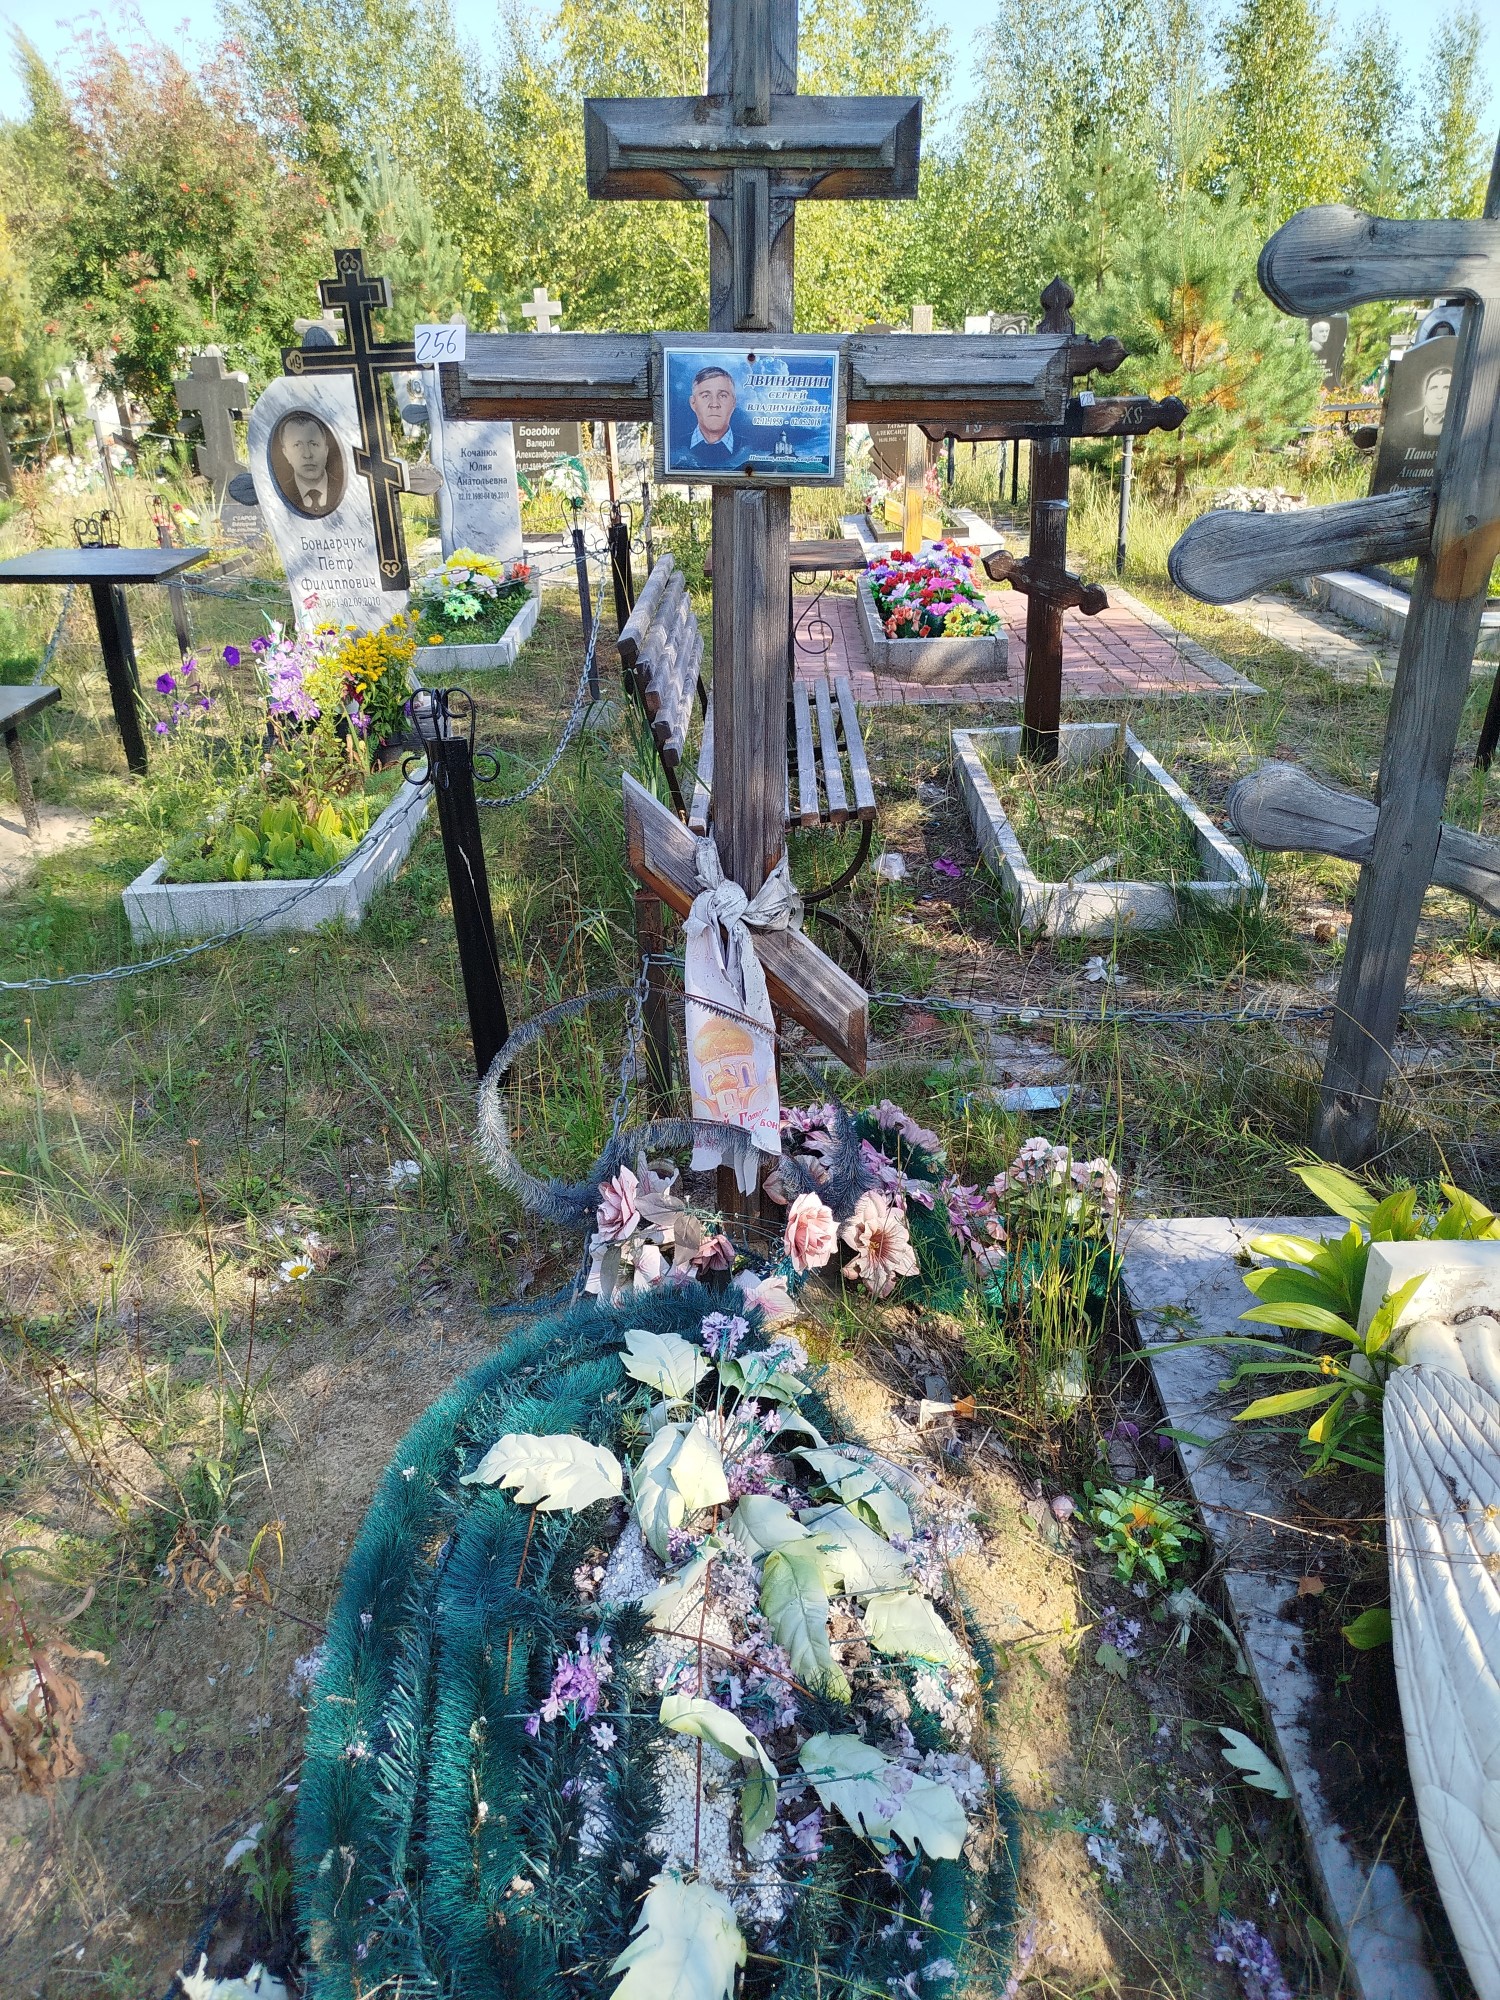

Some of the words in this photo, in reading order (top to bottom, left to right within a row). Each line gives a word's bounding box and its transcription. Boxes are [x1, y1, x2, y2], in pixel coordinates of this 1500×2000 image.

[416, 329, 457, 361] 256
[744, 375, 831, 388] ДВИНЯНИН
[768, 390, 808, 400] СЕРГЕЙ
[746, 404, 830, 413] ВЛАДИМИРОВИЧ
[519, 425, 561, 436] Богодюк
[526, 438, 555, 448] Валерий
[460, 448, 498, 458] Кочанюк
[469, 462, 492, 471] Юлия
[1397, 466, 1434, 478] Анато
[457, 476, 508, 487] Анатольевна
[300, 536, 365, 552] Бондарчук
[318, 556, 354, 572] Пётр
[301, 577, 377, 591] Филиппович
